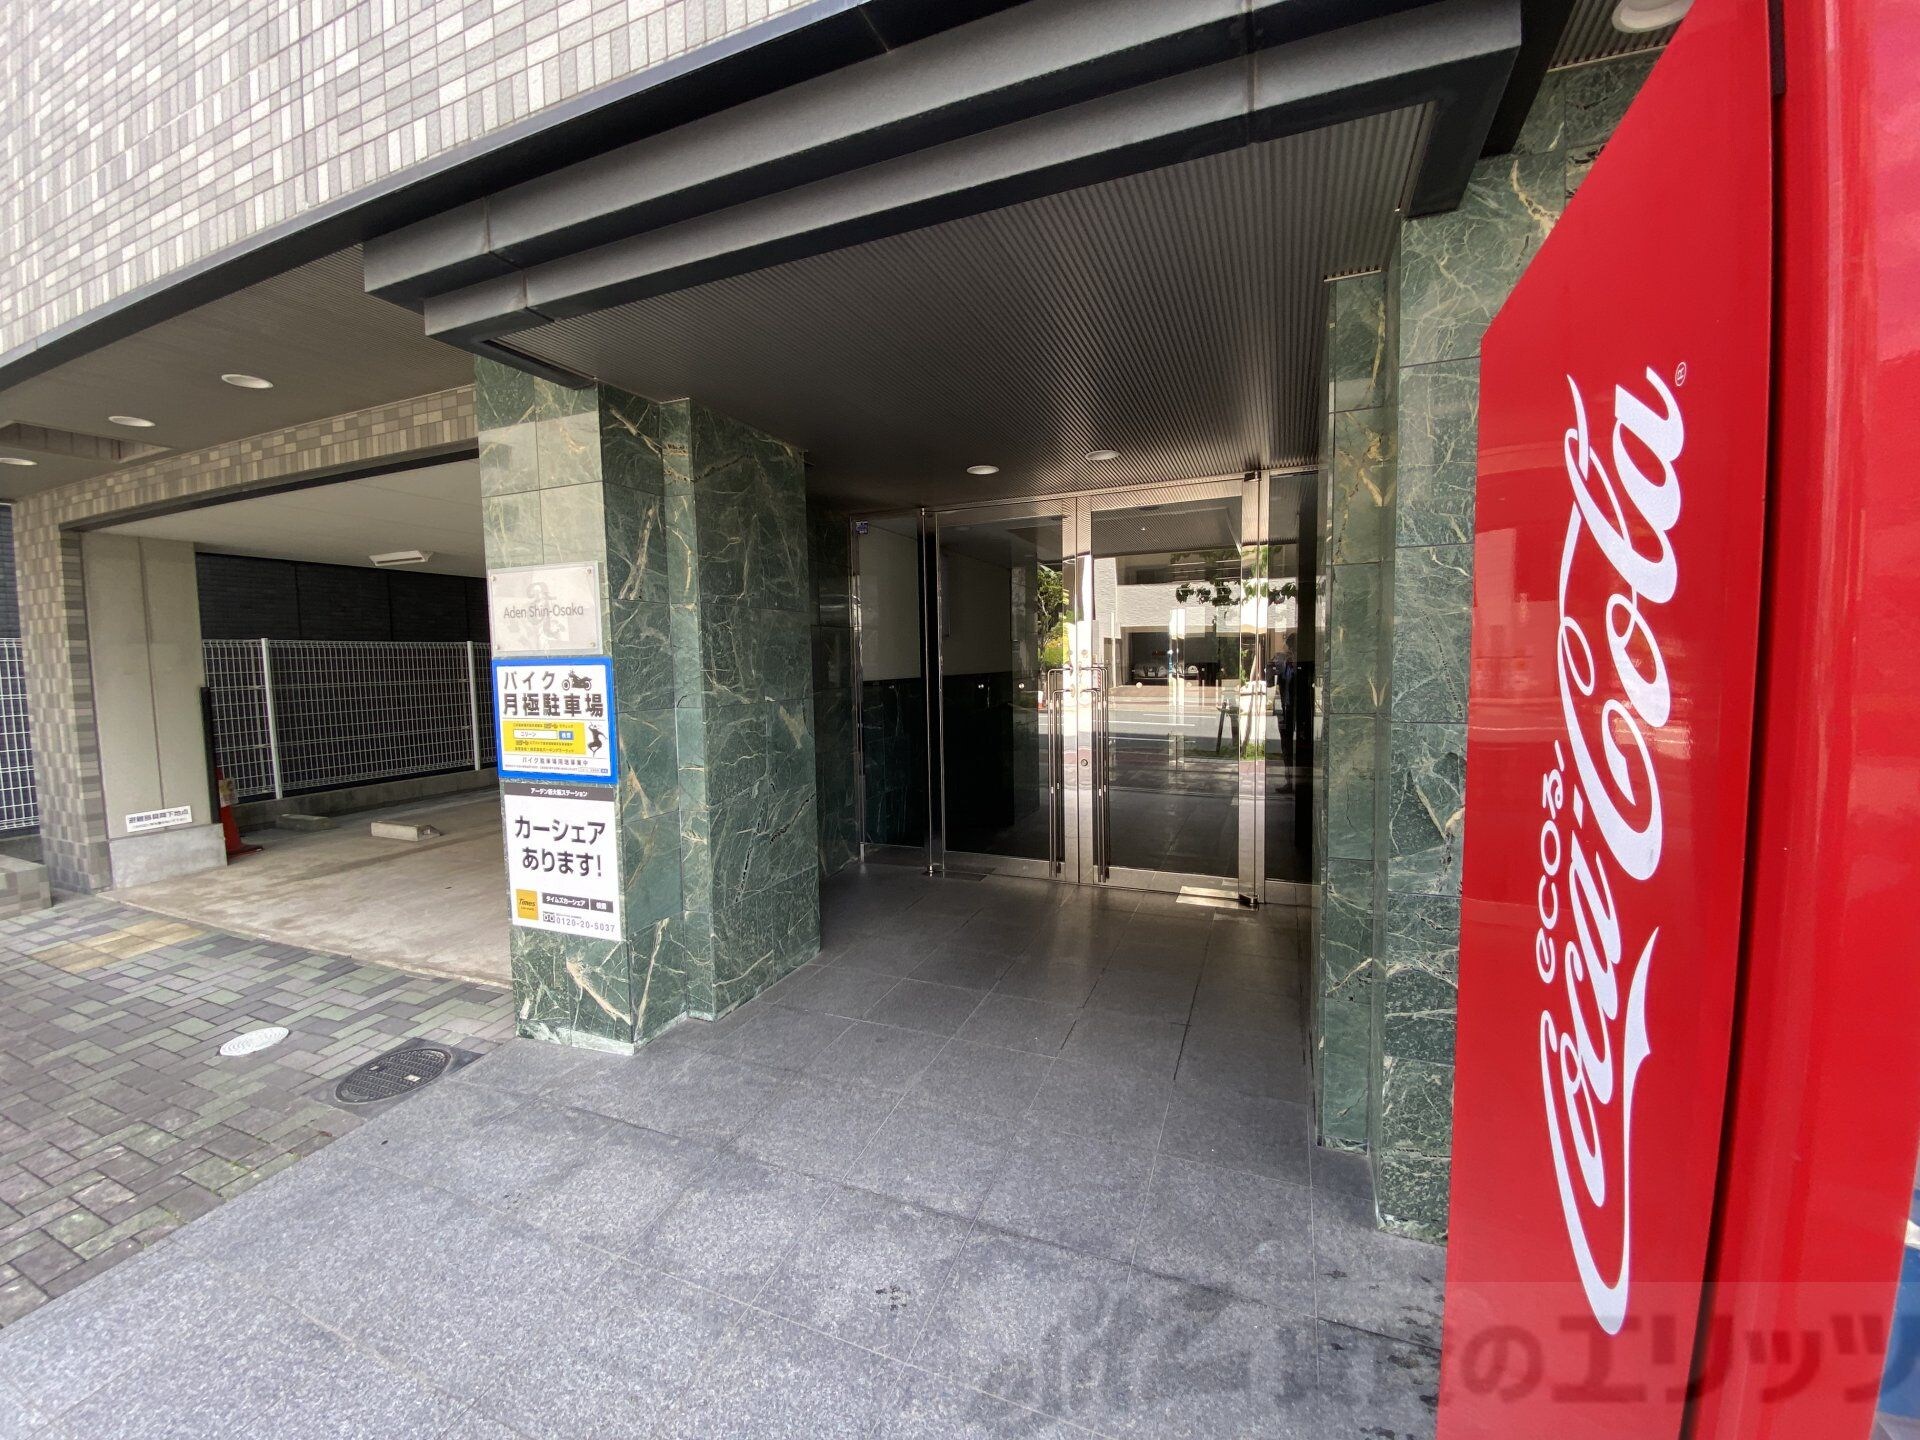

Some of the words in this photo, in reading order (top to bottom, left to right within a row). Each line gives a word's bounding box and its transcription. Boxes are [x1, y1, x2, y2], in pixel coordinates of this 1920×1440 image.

[503, 606, 527, 619] Aden
[529, 602, 584, 618] Shin-Osaka
[504, 671, 555, 690] バイク
[504, 693, 603, 717] 月極駐車場
[514, 815, 606, 845] カーシェア
[1539, 366, 1685, 1335] Coca-Cola
[546, 895, 586, 907] タイムズカーシェア
[556, 917, 615, 933] 0120-20-5037
